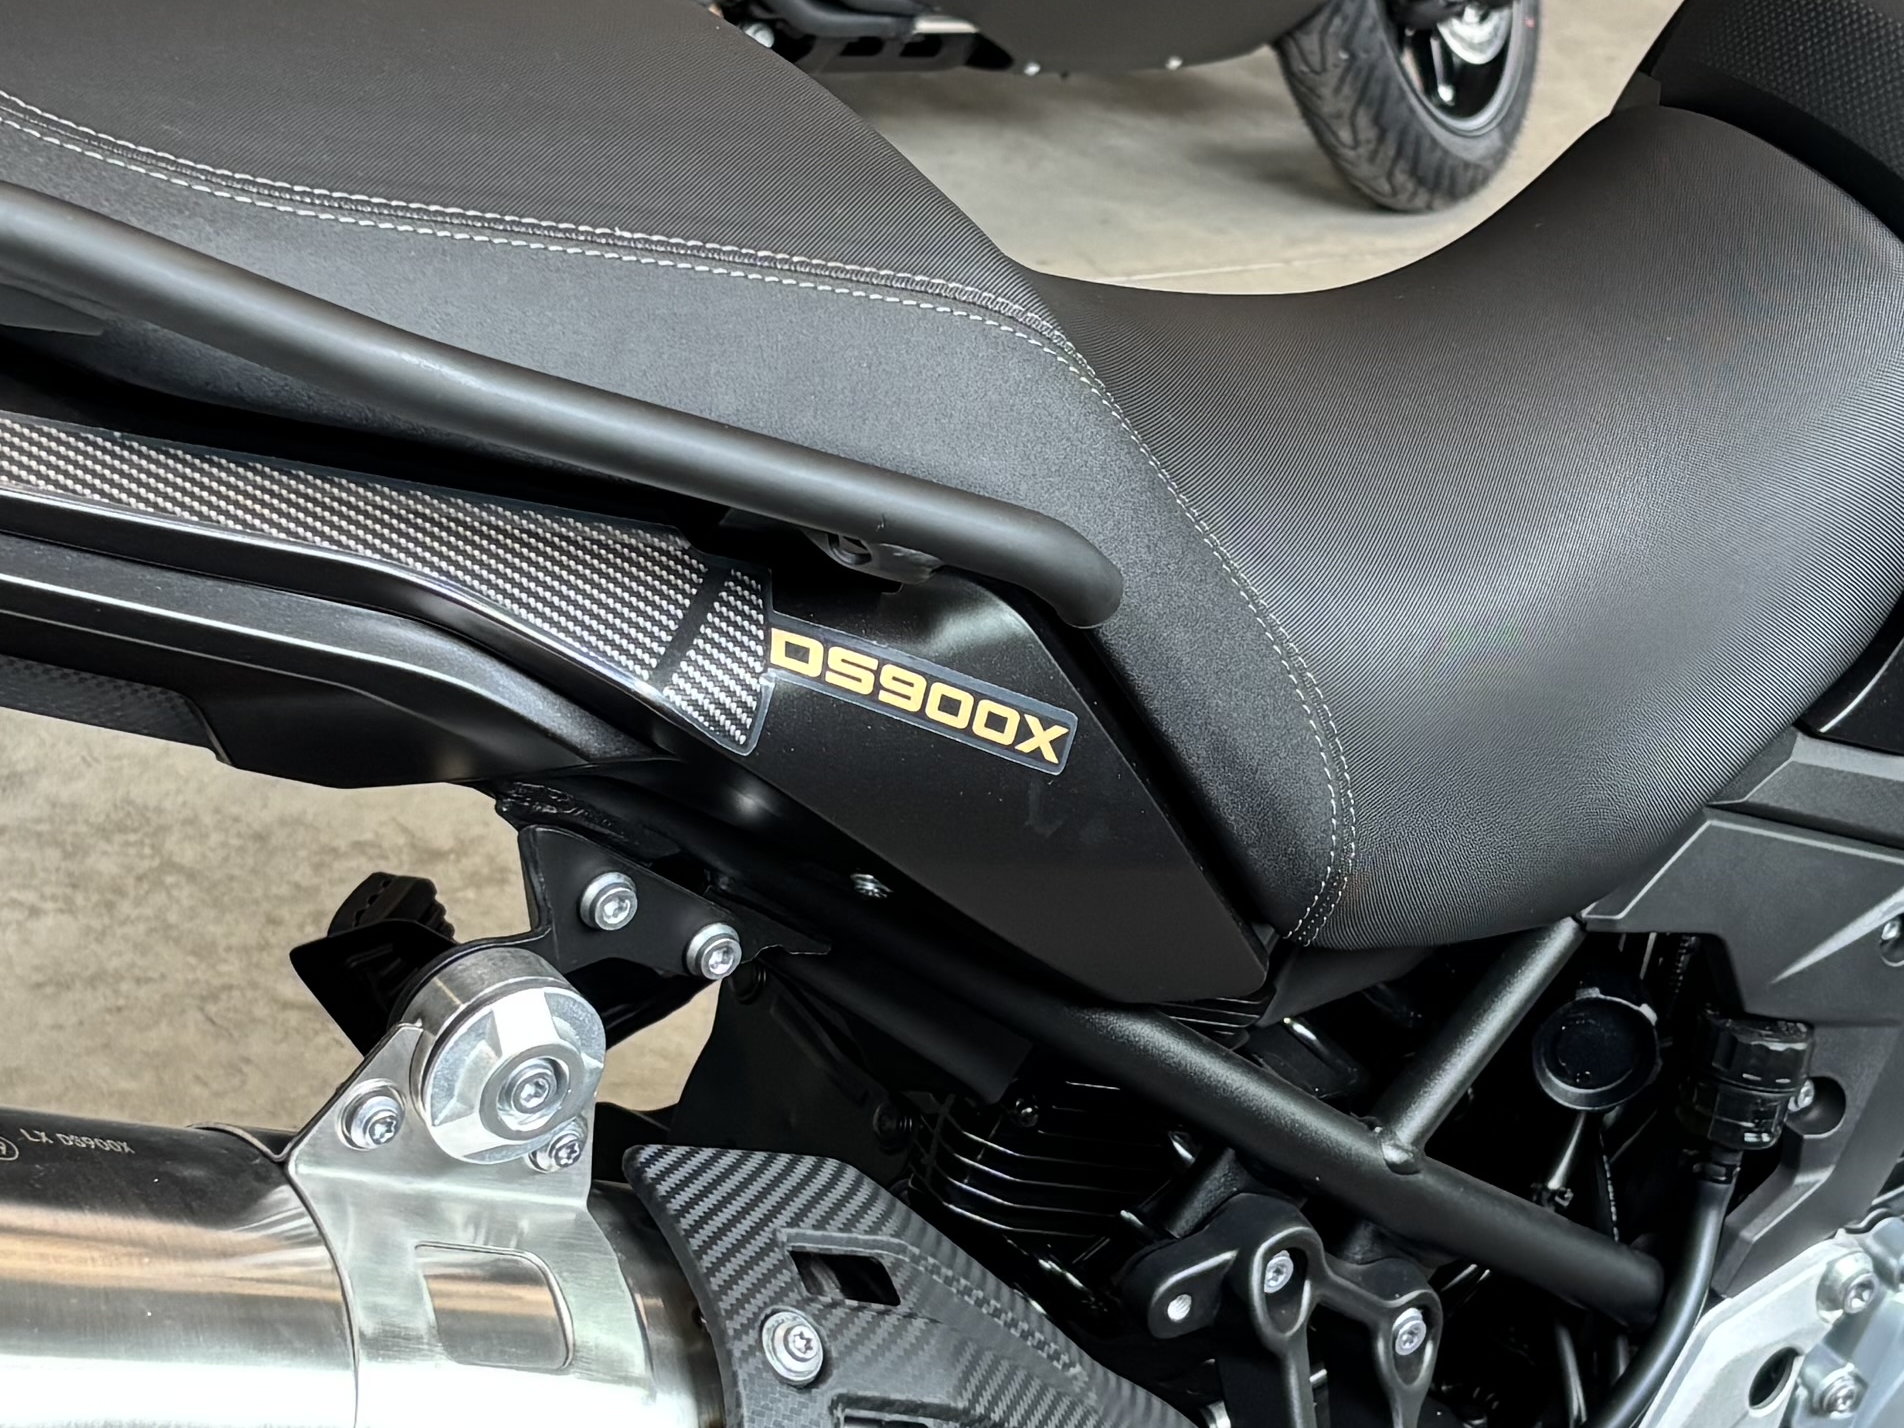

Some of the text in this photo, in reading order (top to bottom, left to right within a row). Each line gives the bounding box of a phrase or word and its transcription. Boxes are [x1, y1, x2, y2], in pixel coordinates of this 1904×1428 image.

[769, 627, 1069, 765] DS900X
[19, 1128, 136, 1154] LX DS900X
